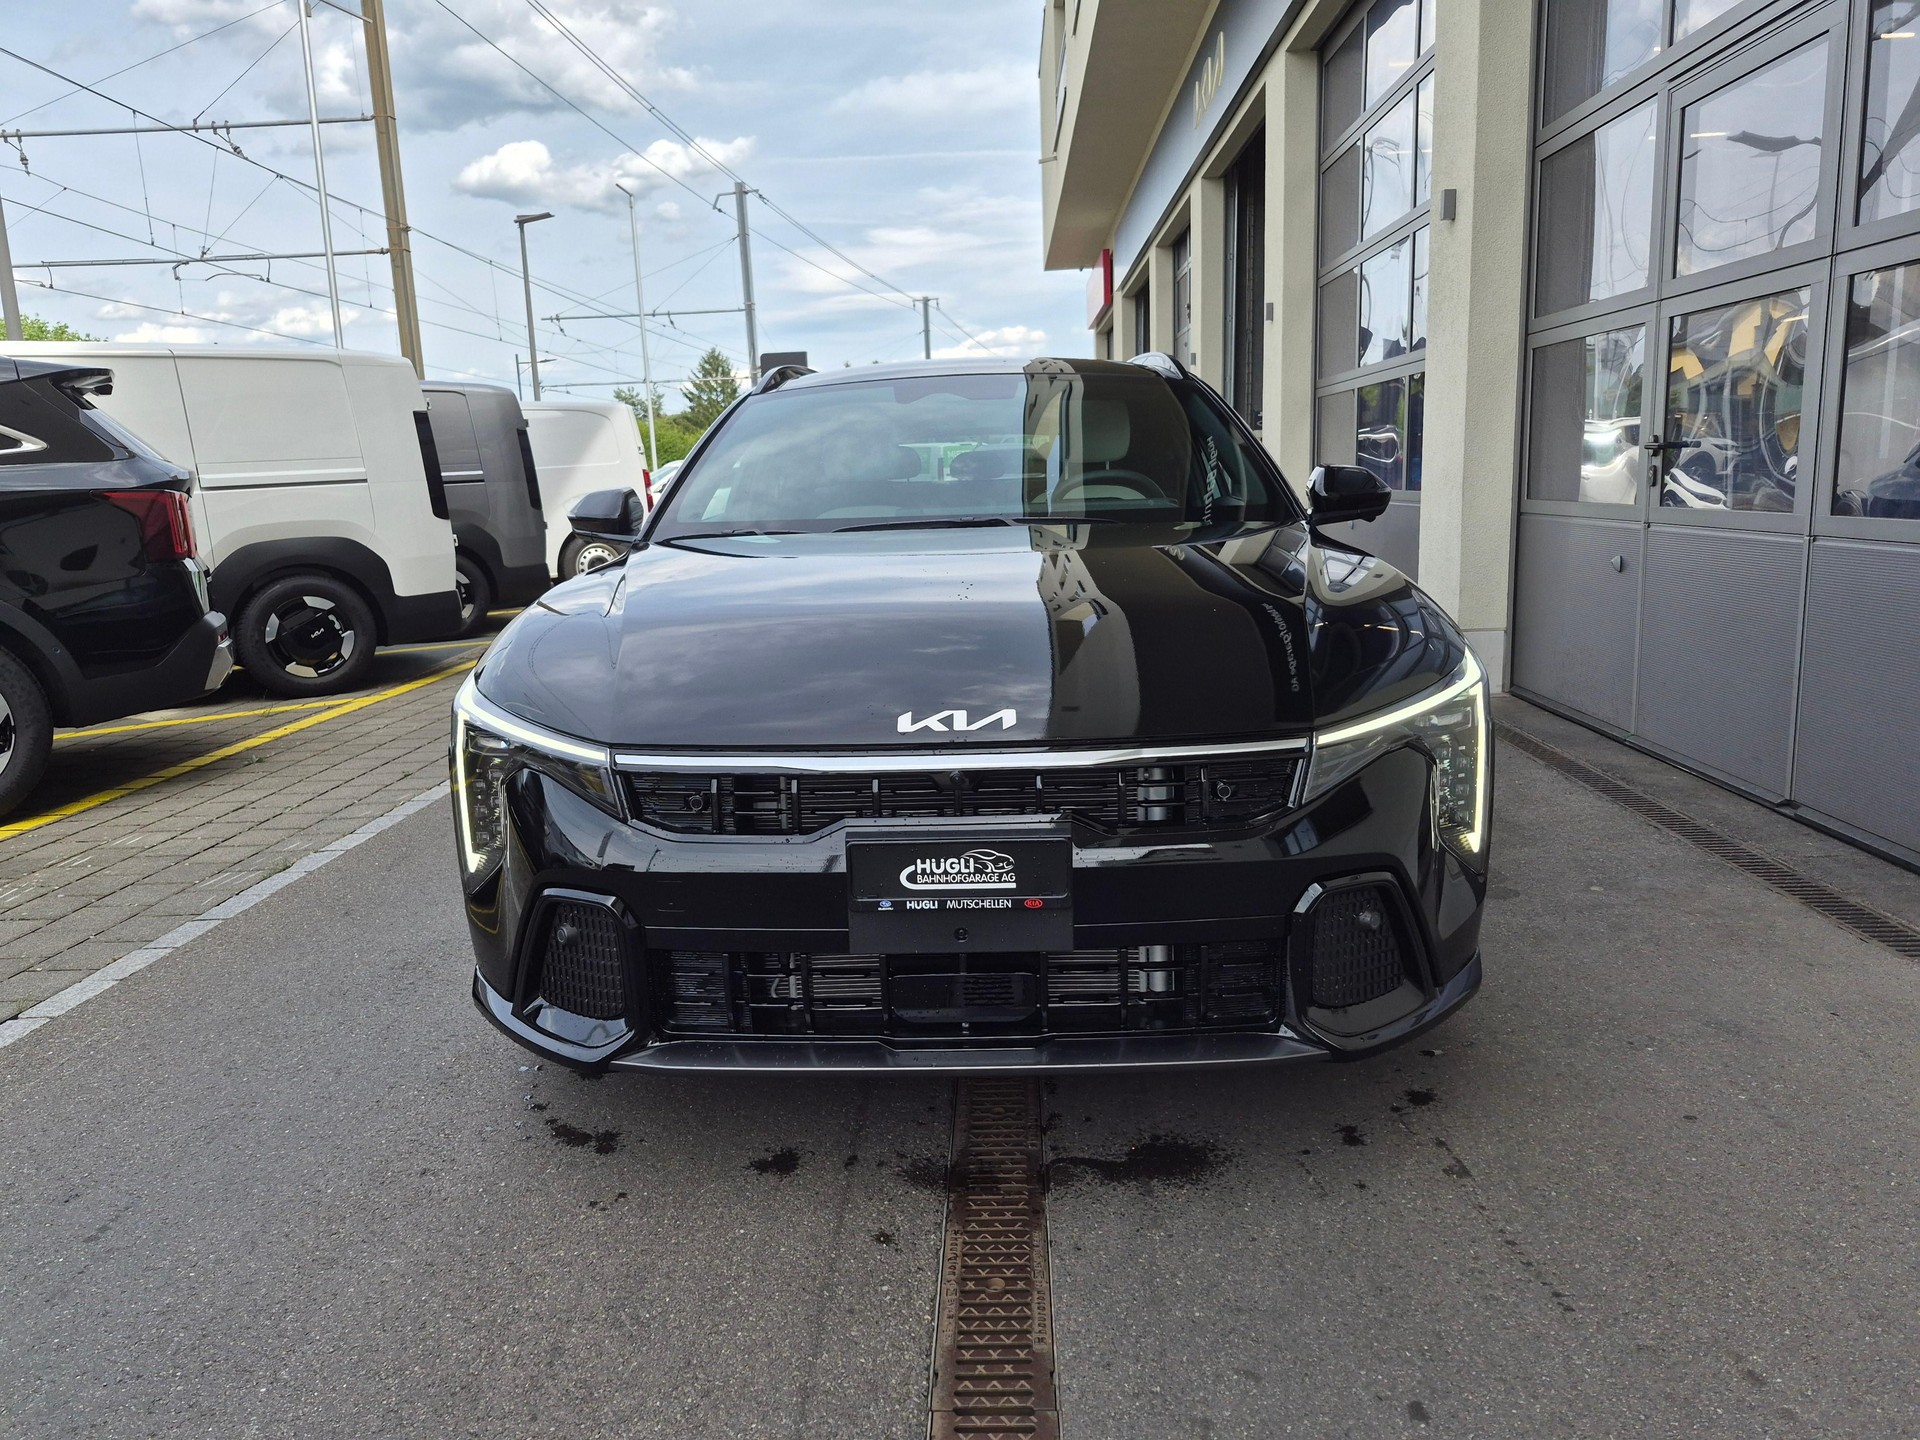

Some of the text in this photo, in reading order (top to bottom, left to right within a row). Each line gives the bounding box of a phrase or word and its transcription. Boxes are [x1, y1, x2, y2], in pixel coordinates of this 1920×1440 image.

[897, 708, 1017, 733] KIA
[917, 873, 1016, 883] BAHNHOFGARAGE AG
[946, 899, 1012, 909] MUTSCHELLEN
